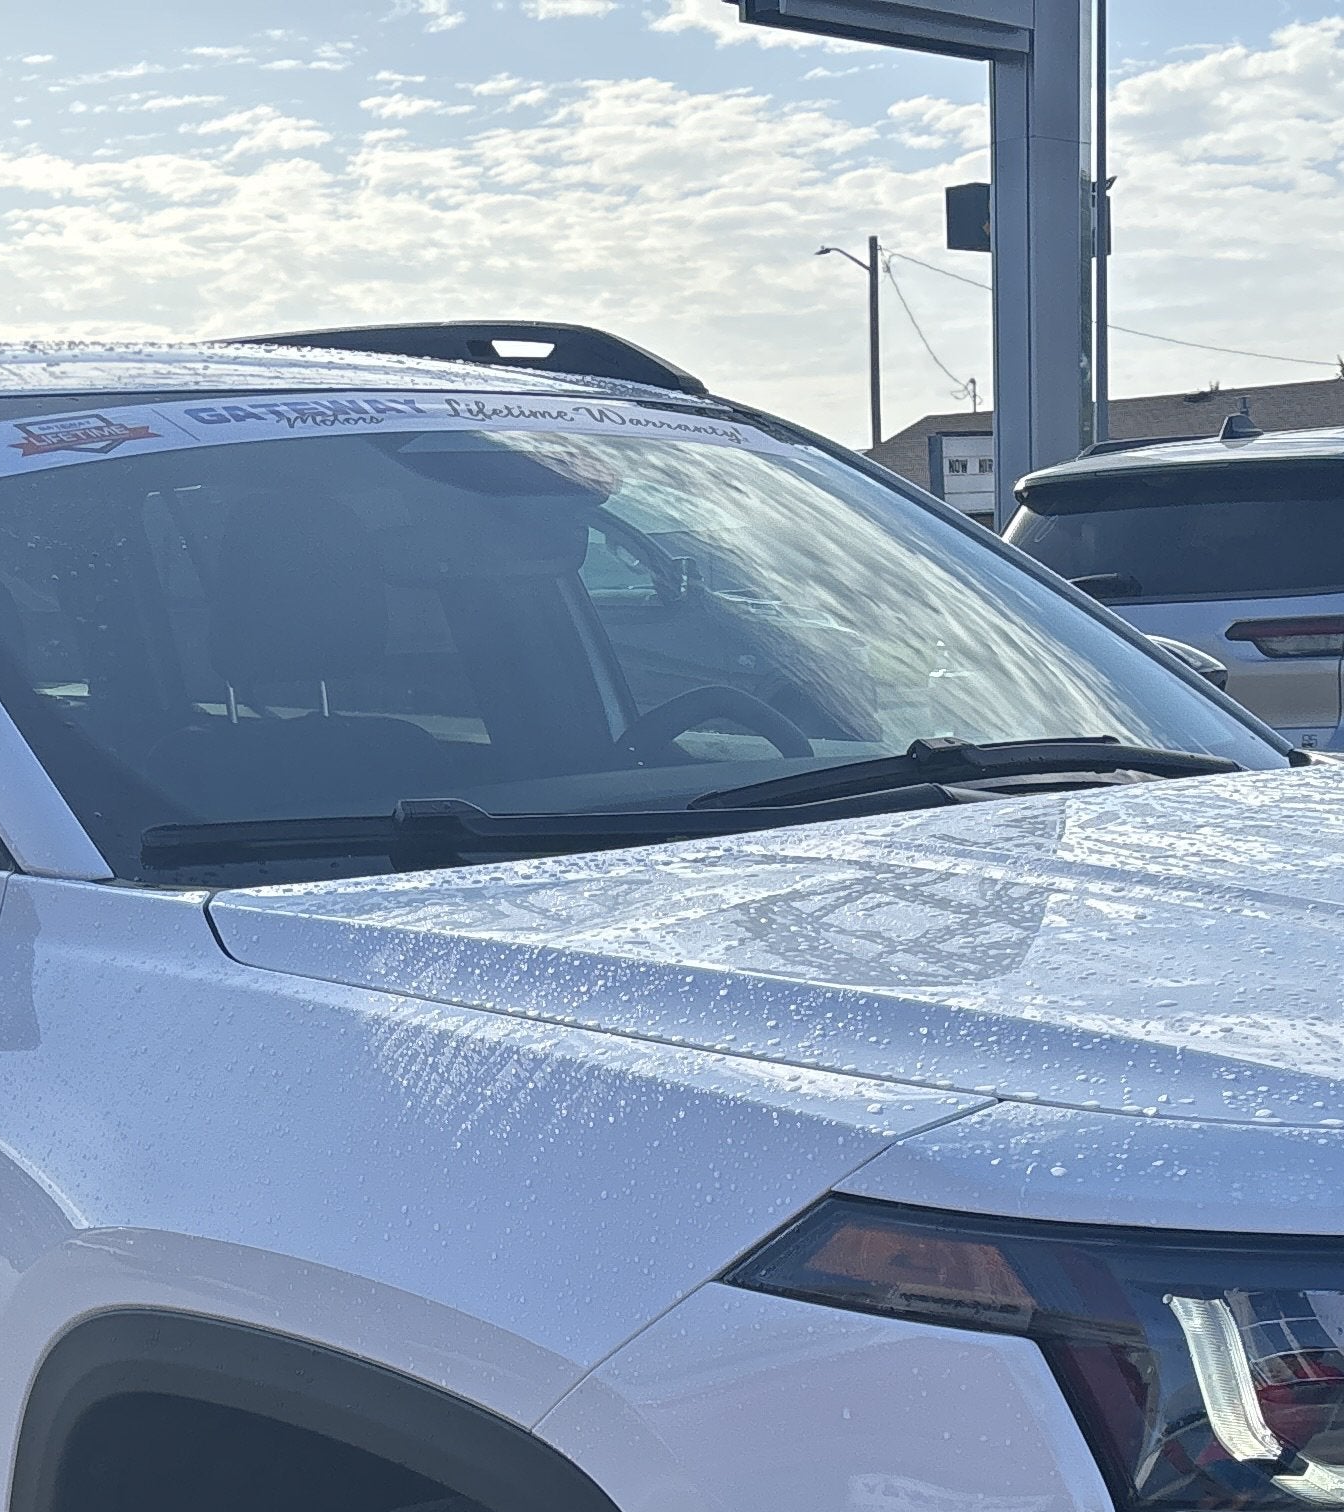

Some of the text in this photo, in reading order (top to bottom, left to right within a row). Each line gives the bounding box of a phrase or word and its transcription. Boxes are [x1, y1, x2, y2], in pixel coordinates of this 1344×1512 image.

[184, 400, 426, 425] GATEWAY
[444, 398, 574, 422] Lifetime
[276, 414, 384, 429] Motors
[28, 424, 130, 446] LIFETIME
[949, 459, 968, 473] NOW
